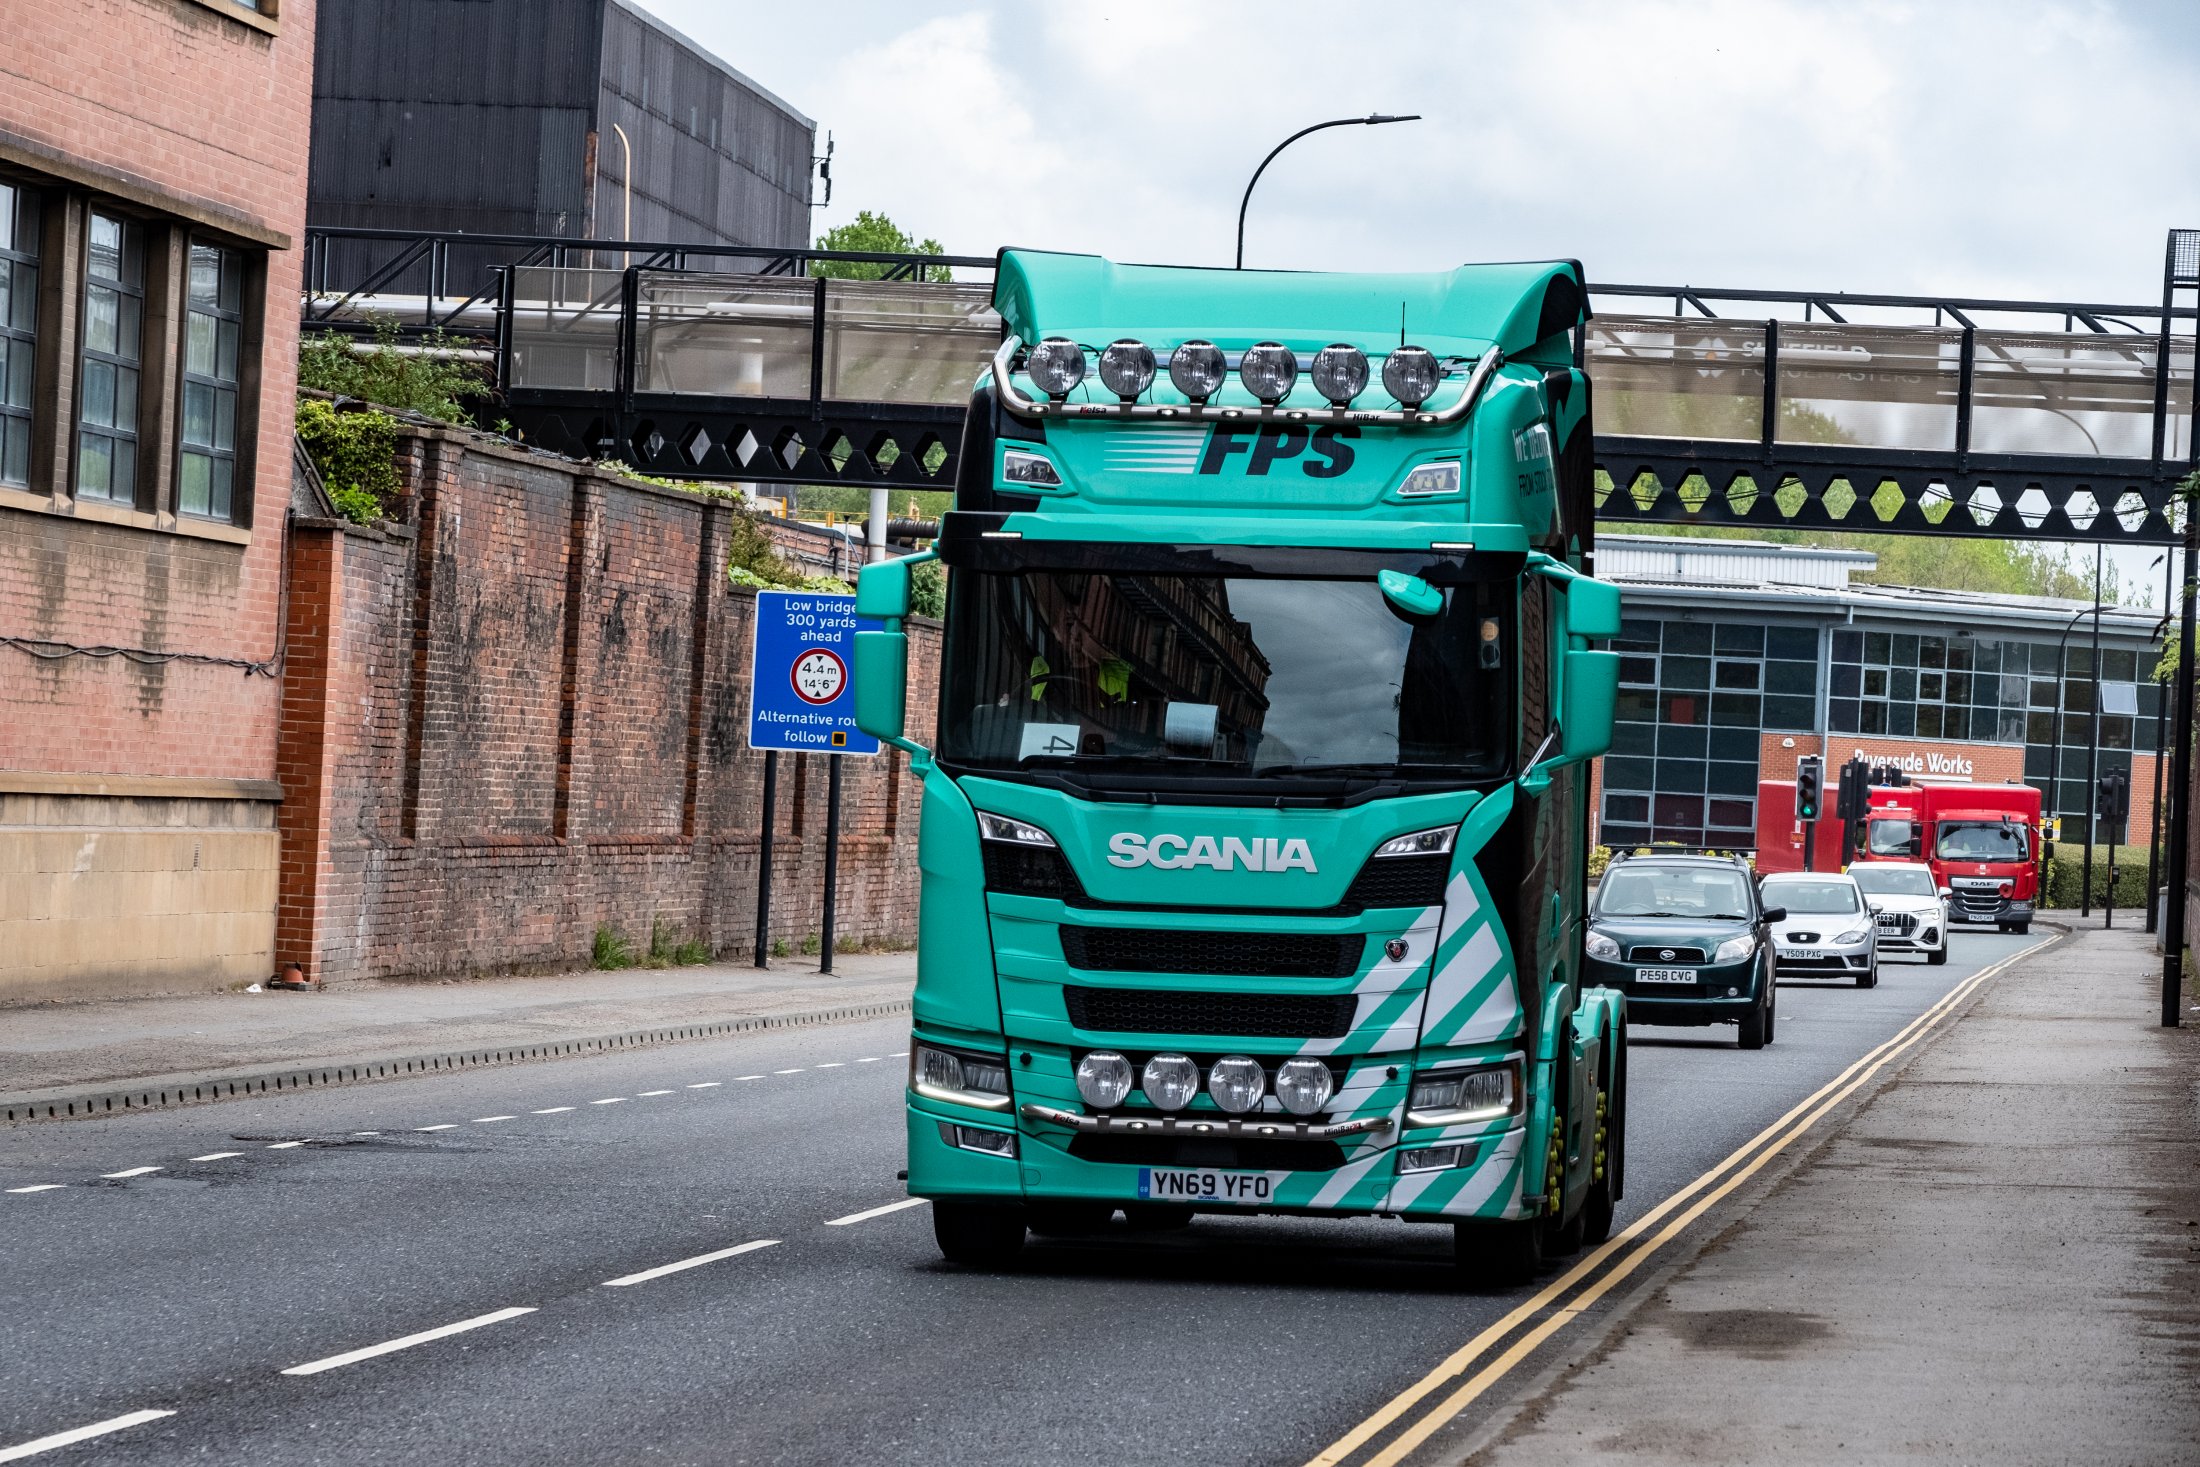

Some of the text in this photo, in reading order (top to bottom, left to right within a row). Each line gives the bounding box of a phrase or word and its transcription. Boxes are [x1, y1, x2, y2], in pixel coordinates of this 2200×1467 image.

[1080, 406, 1107, 415] Kelsa
[1353, 413, 1381, 421] HiBar
[1199, 421, 1362, 479] FPS
[785, 599, 856, 616] Low bridge
[786, 613, 857, 629] 300 yards
[800, 629, 842, 643] ahead
[802, 662, 837, 675] 4.4 m
[758, 709, 857, 727] Alternative rou
[784, 729, 828, 744] follow
[1854, 748, 1973, 775] Riverside Works
[1106, 832, 1319, 874] SCANIA
[1785, 950, 1821, 958] YS09 PXG
[1640, 970, 1692, 981] PE58 CVG
[1154, 1172, 1269, 1198] YN69 YFO
